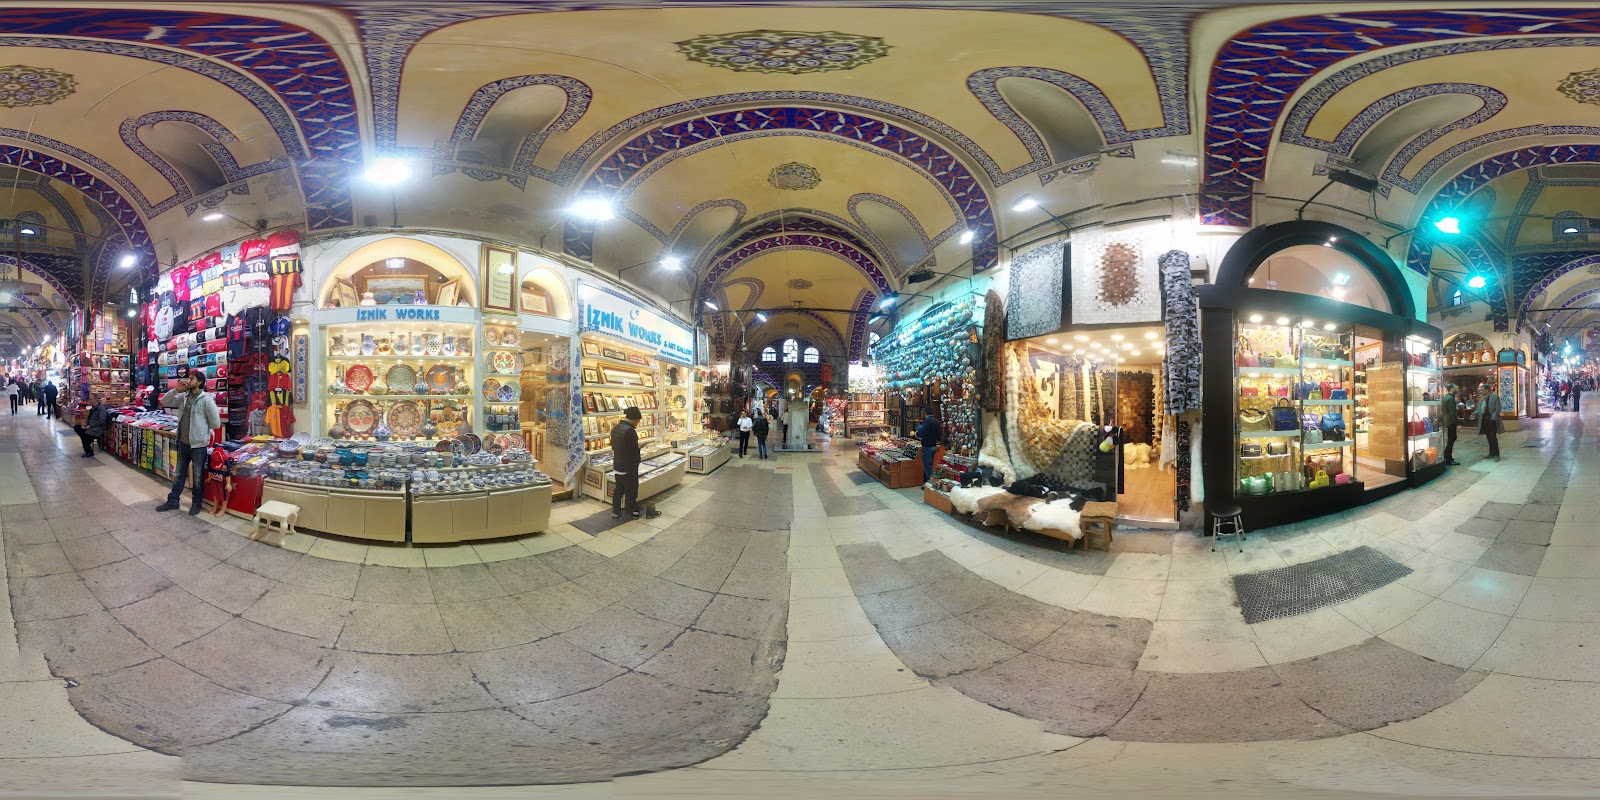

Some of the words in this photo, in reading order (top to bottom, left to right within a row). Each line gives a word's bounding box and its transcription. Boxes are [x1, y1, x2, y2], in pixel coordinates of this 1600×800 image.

[230, 290, 237, 303] 7
[191, 304, 202, 320] 11
[357, 307, 387, 321] İZNİK
[395, 308, 440, 321] WORKS
[628, 321, 662, 346] WORKS
[663, 340, 667, 348] &
[667, 341, 676, 350] ART
[676, 345, 692, 355] GALLERY
